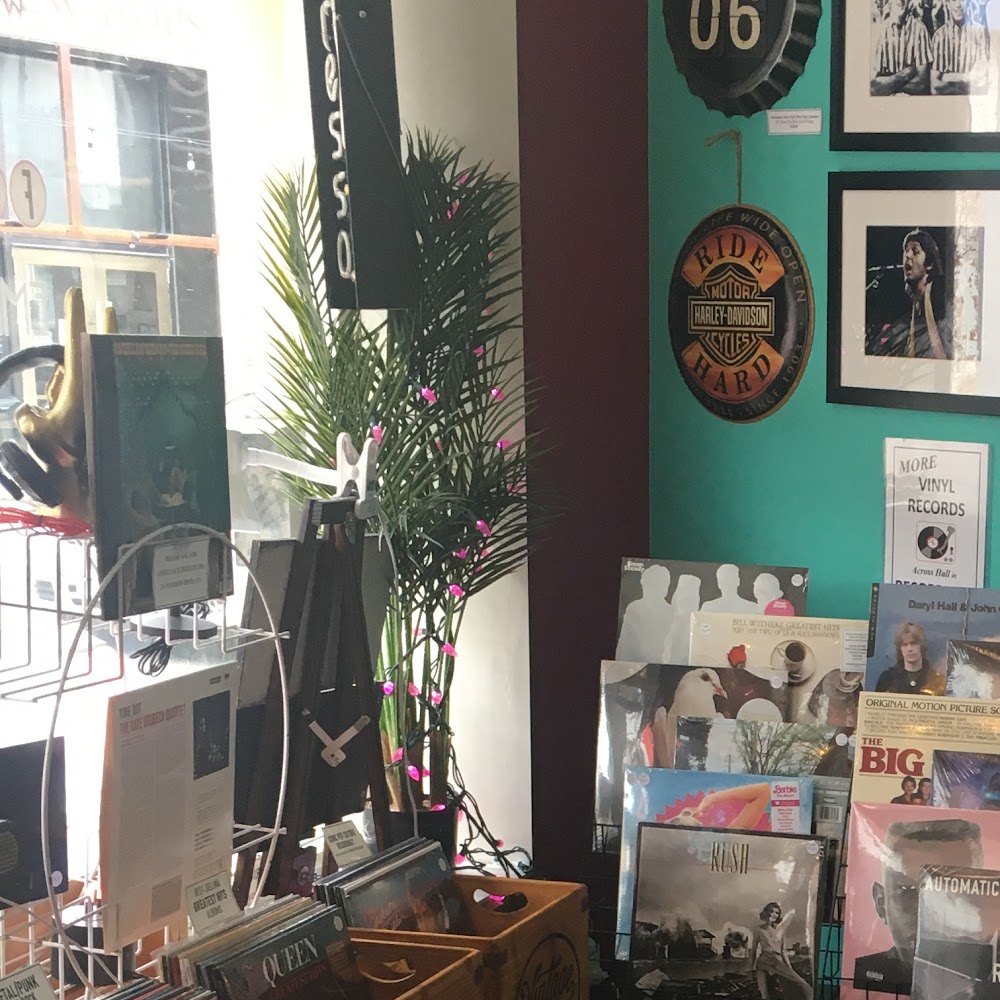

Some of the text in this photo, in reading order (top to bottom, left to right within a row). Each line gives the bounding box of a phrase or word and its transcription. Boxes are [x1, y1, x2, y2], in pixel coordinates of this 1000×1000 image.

[694, 232, 769, 273] RIDE
[740, 213, 780, 238] WIDE
[781, 245, 807, 303] OPEN
[711, 284, 751, 299] MOTOR
[694, 305, 768, 327] HARLEY-DAVIDSON
[711, 332, 751, 358] CYCLES
[784, 344, 804, 383] 1903
[692, 353, 771, 395] HARD
[899, 455, 938, 474] MORE
[918, 477, 956, 493] VINYL
[908, 498, 965, 517] RECORDS
[912, 566, 934, 577] Across
[935, 568, 951, 579] Hall
[909, 599, 934, 612] Daryl
[937, 601, 957, 612] Hall
[960, 602, 967, 612] &
[971, 603, 996, 614] John
[732, 619, 841, 632] BILL WITHERS GREATEST HITS
[865, 698, 909, 709] ORIGINAL
[911, 702, 947, 712] MOTION
[950, 704, 987, 714] PICTURE
[862, 737, 883, 746] THE
[859, 746, 925, 777] BIG
[710, 841, 750, 875] RUSH
[925, 877, 999, 897] AUTOMATIC
[262, 935, 319, 988] QUEEN
